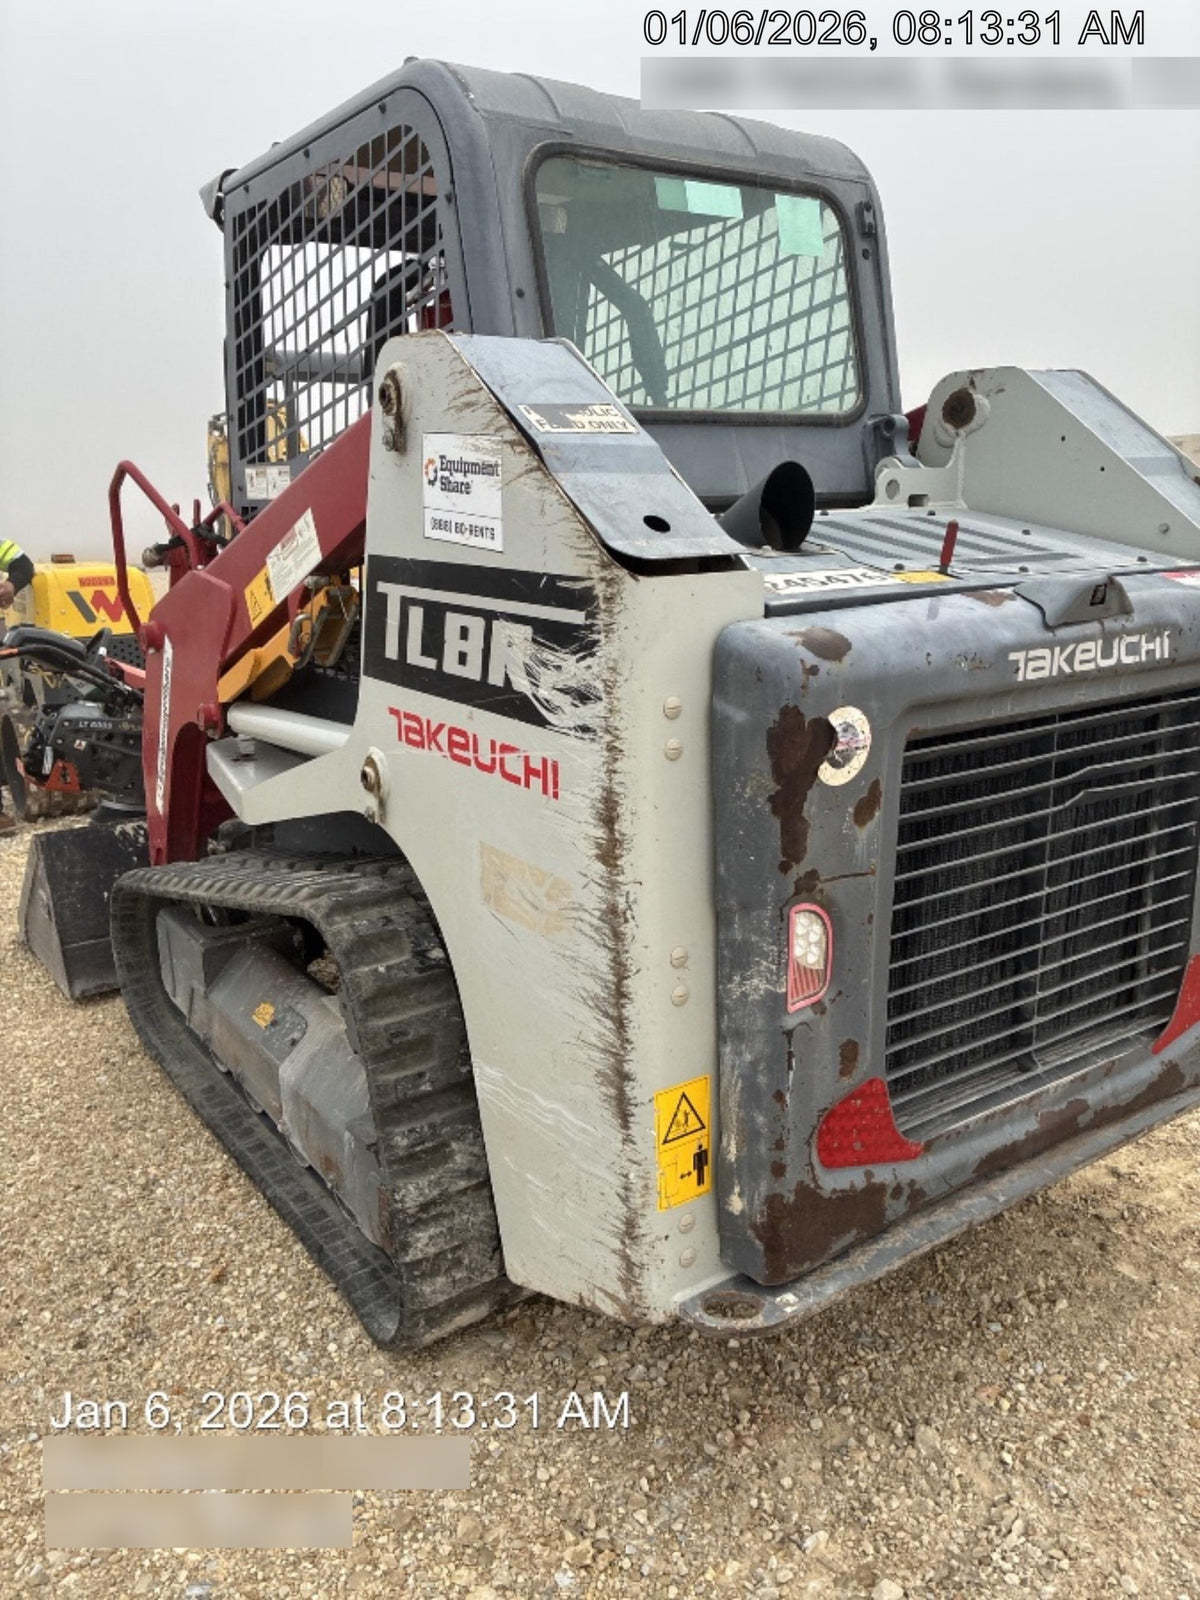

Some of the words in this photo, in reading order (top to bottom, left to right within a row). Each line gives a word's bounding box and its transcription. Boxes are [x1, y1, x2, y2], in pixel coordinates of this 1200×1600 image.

[588, 420, 629, 430] ONLY
[438, 455, 501, 478] Equipment
[439, 476, 472, 496] Share
[1008, 630, 1171, 682] TAKEUCHI
[388, 706, 560, 800] TAKEUCHI
